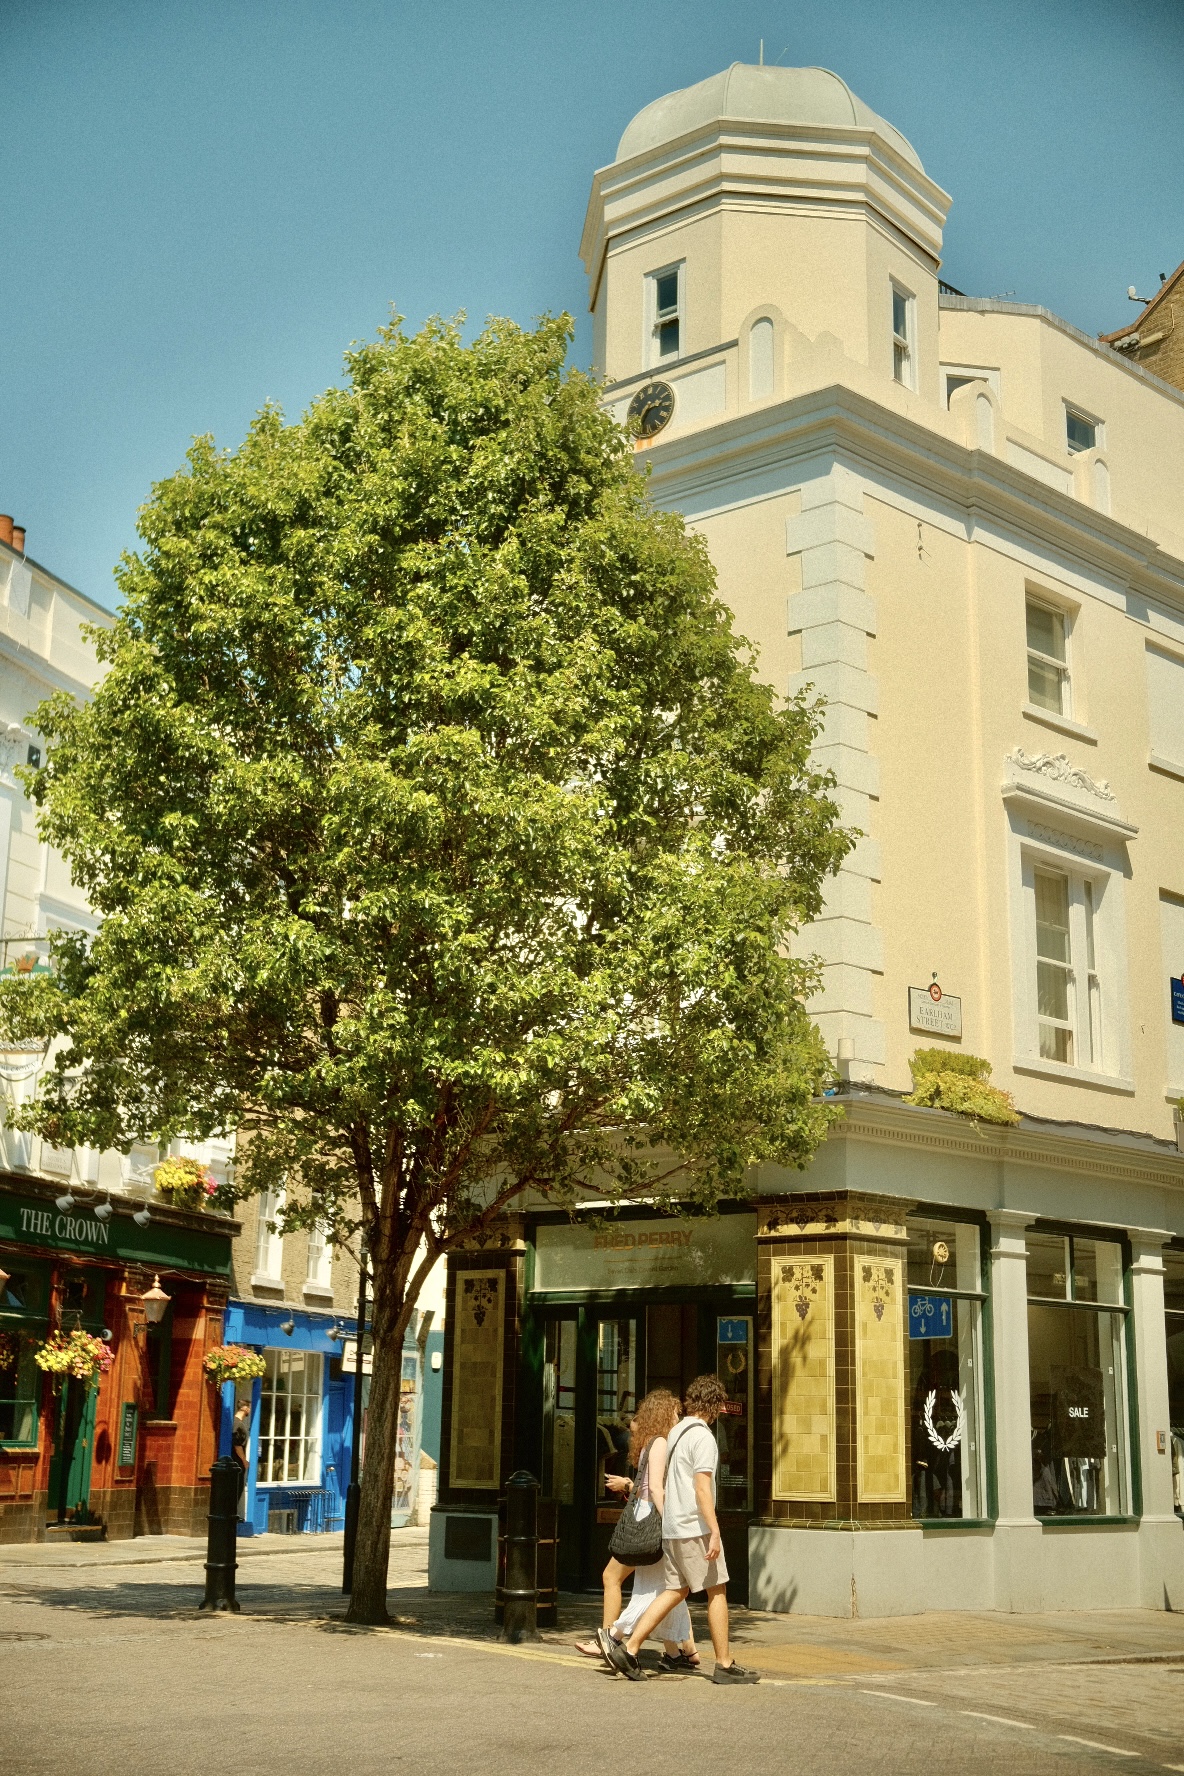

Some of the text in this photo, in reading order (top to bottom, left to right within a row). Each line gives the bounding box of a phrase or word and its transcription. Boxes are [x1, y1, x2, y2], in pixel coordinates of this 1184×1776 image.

[919, 1006, 953, 1021] EARLHAM
[916, 1015, 943, 1029] STREET
[20, 1208, 109, 1245] THE CROWN
[593, 1230, 693, 1252] FRED PERRY
[1069, 1407, 1089, 1418] SALE
